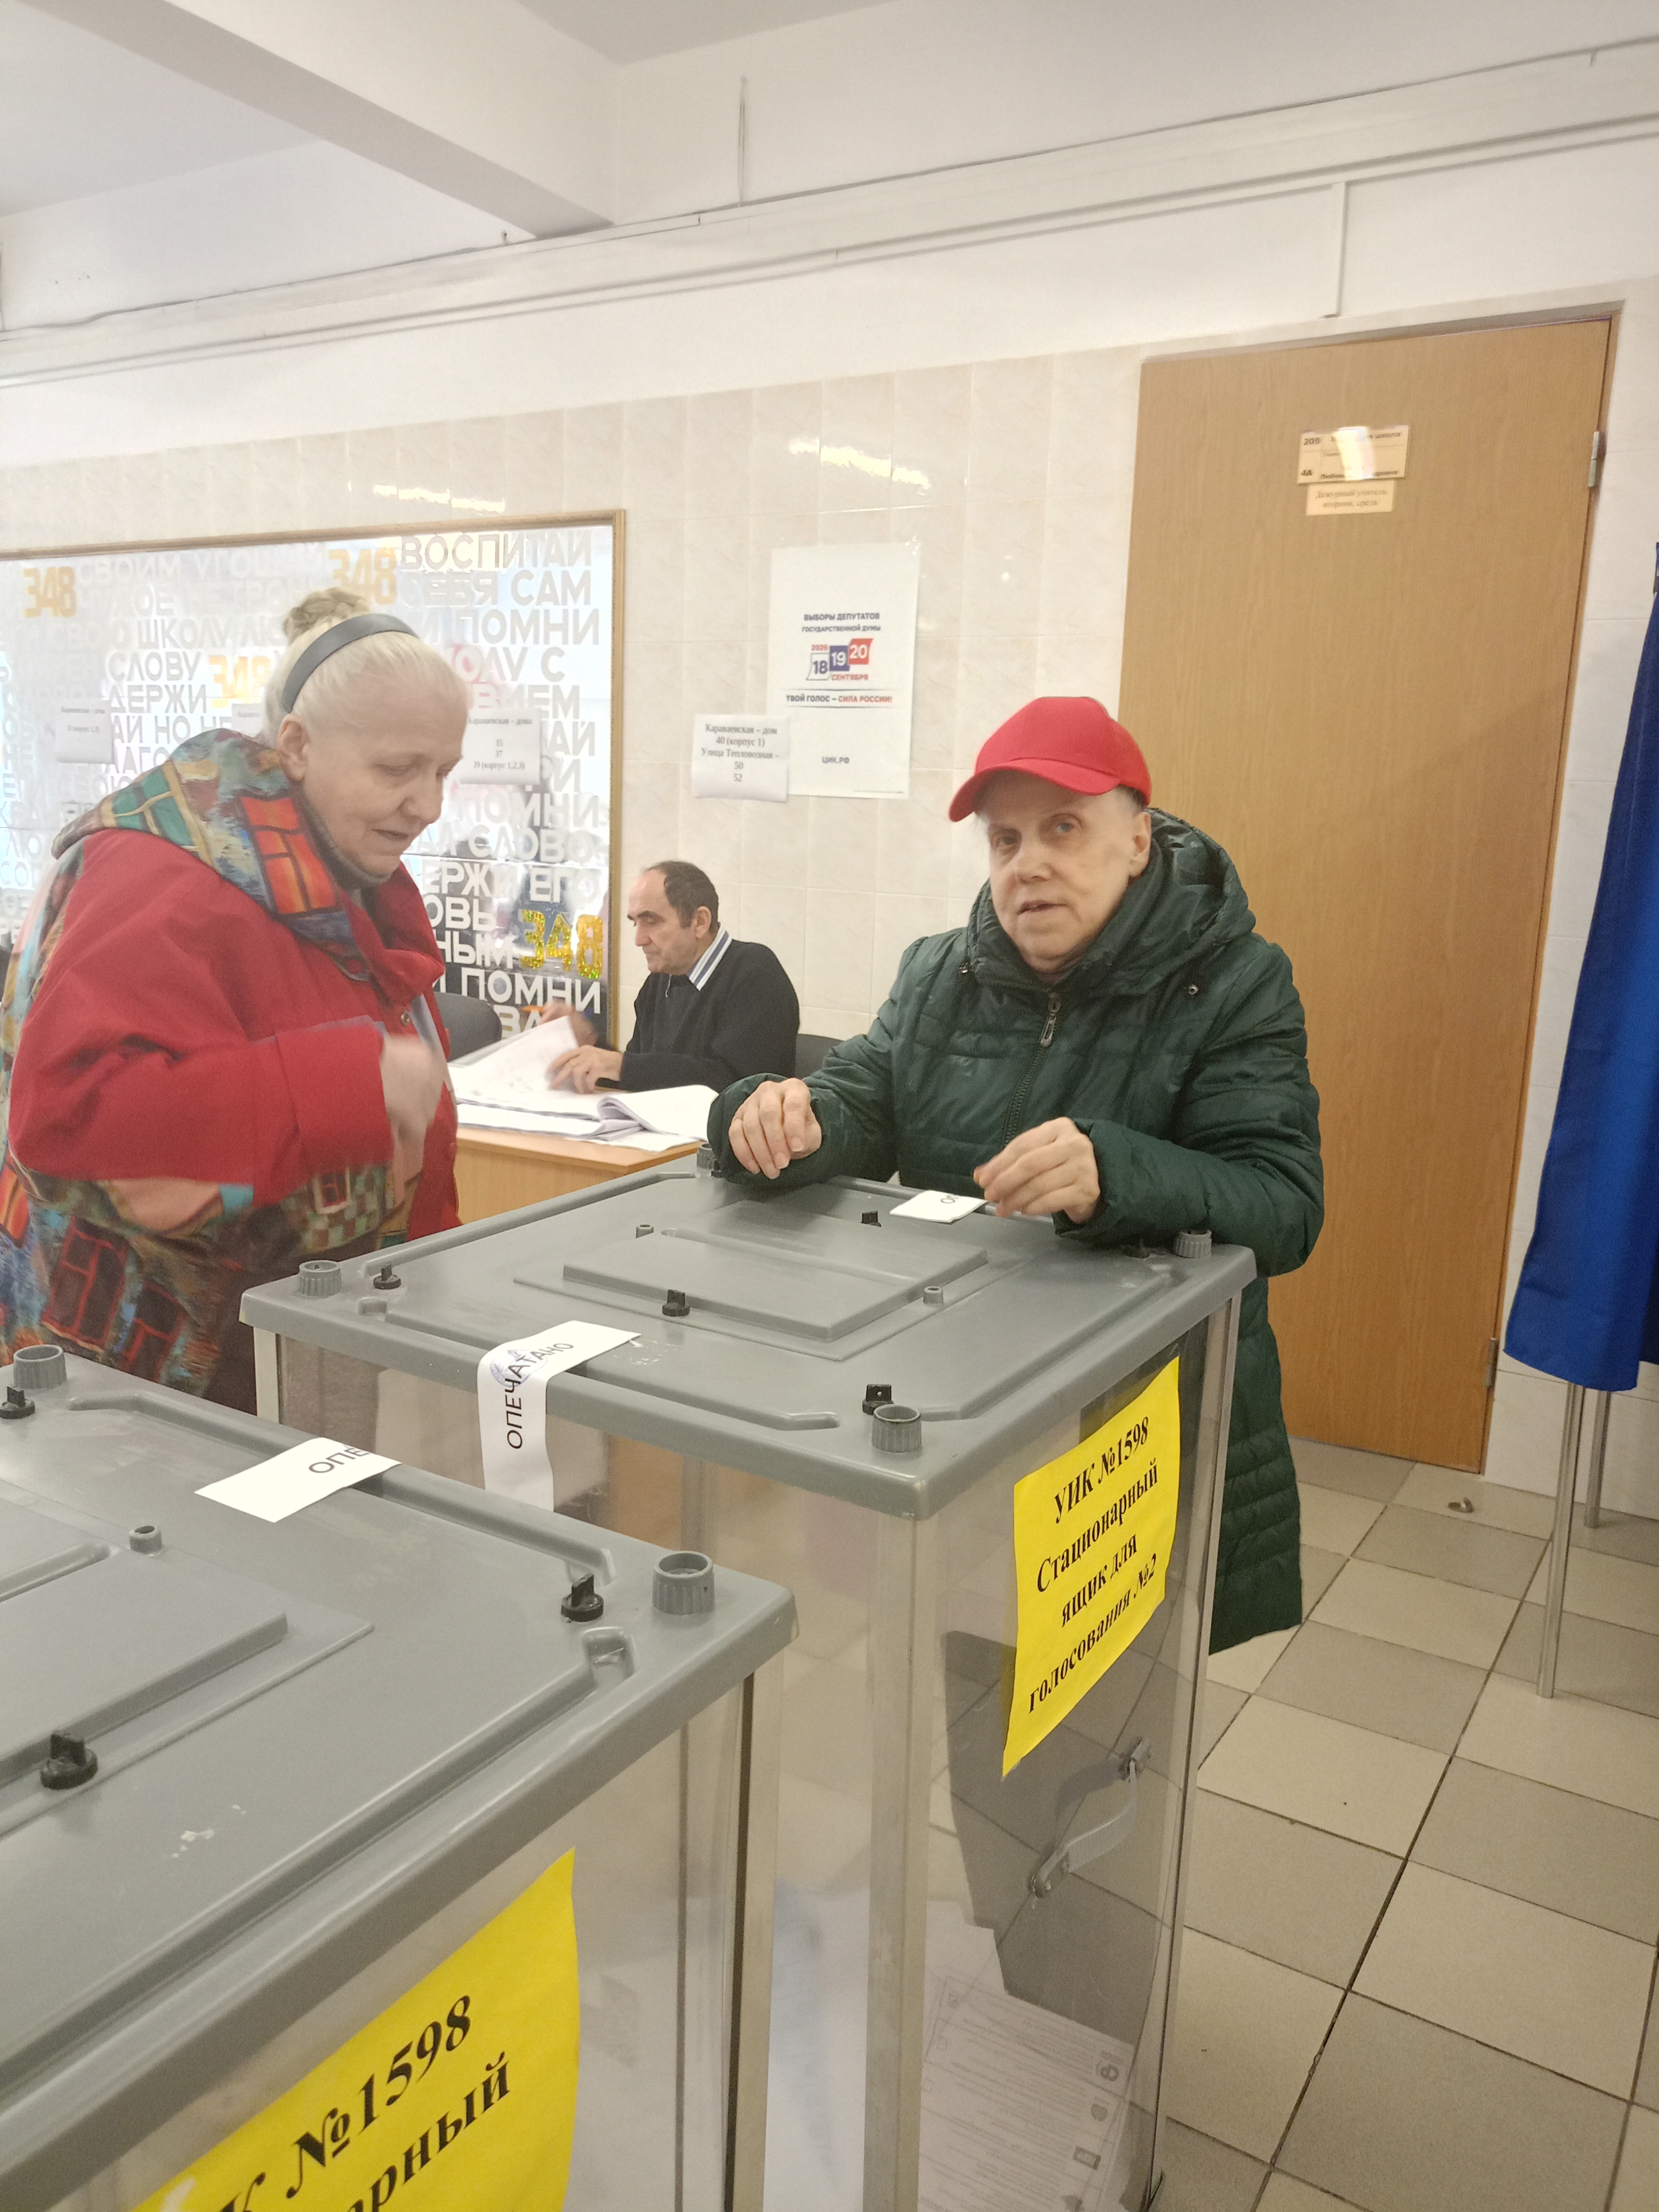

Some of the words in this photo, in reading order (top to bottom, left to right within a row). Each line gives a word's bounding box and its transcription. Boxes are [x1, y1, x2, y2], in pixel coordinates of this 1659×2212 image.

[1304, 437, 1320, 445] 209
[23, 566, 77, 618] 348
[511, 569, 591, 606] САМ
[137, 617, 233, 650] ШКОЛУ
[455, 608, 599, 646] ПОМНИ
[802, 624, 861, 632] ГОСУДАРСТВЕННОЙ
[837, 613, 880, 621] ДЕПУТАТОВ
[108, 652, 202, 682] СЛОВУ
[541, 647, 565, 683] С
[813, 660, 829, 675] 18
[831, 652, 847, 666] 19
[850, 644, 868, 659] 20
[109, 684, 207, 714] ДЕРЖИ
[786, 694, 805, 702] ТВОЙ
[154, 715, 191, 744] НО
[705, 724, 754, 735] Караваевская
[716, 736, 725, 745] 40
[727, 737, 755, 748] (корпус
[701, 748, 724, 757] Улица
[726, 749, 773, 759] Тепловозная
[734, 761, 744, 770] 50
[733, 774, 743, 782] 52
[530, 865, 602, 904] ЕГО
[520, 908, 604, 979] 348
[461, 966, 601, 1014] ПОМНИ
[505, 1343, 574, 1449] ОПЕЧАТАНО
[1054, 1462, 1095, 1524] УИК
[1098, 1416, 1149, 1484] №1598
[1037, 1457, 1158, 1593] Стационарный
[1062, 1565, 1107, 1627] ящик
[1110, 1534, 1138, 1582] для
[1029, 1588, 1131, 1714] голосования
[1133, 1553, 1157, 1599] №2
[287, 1995, 471, 2199] №1598
